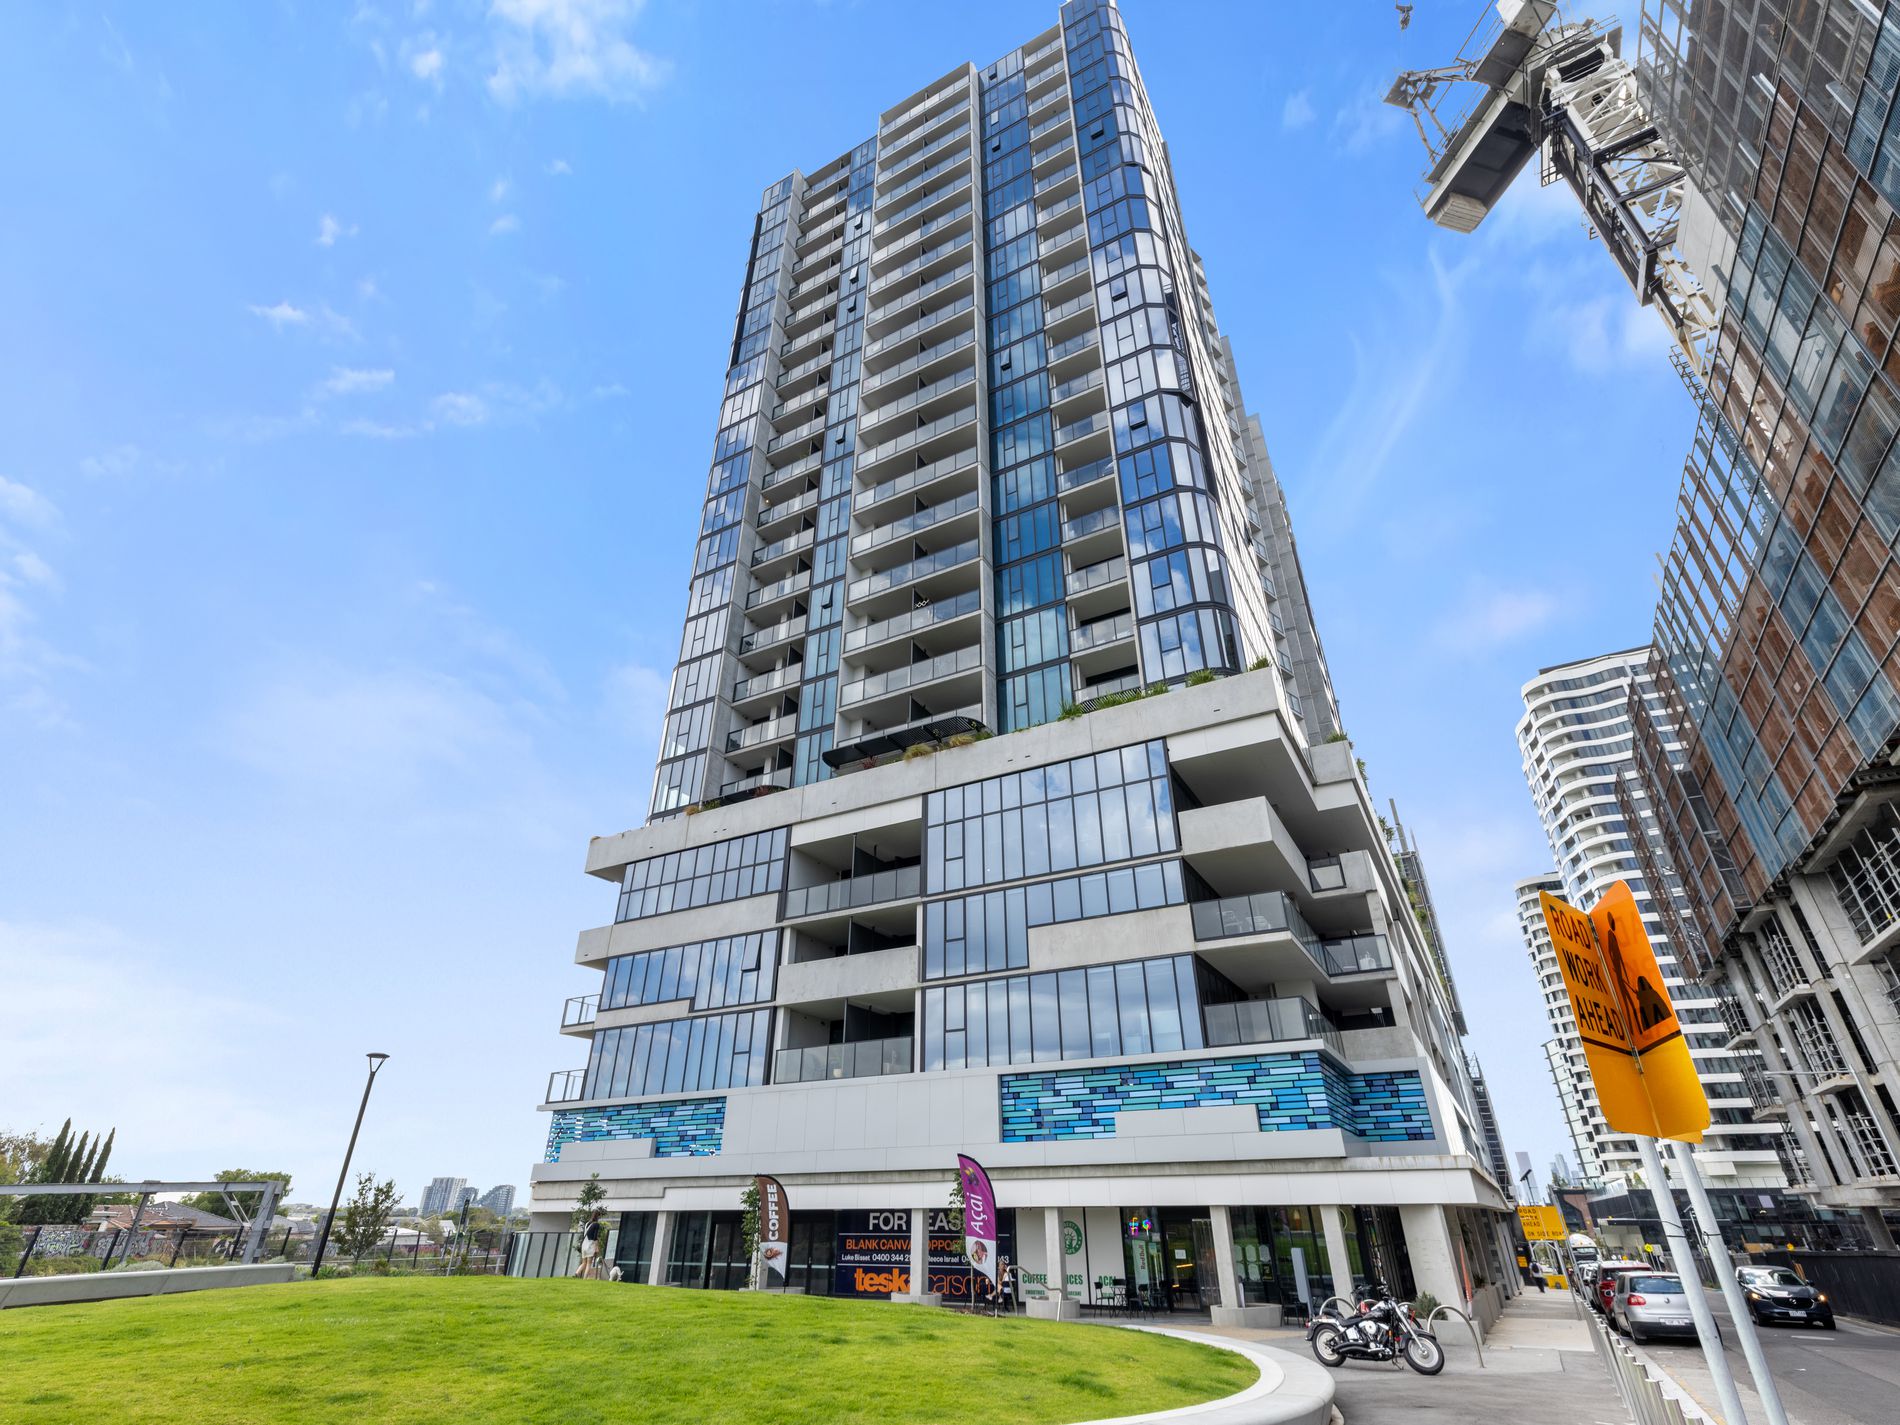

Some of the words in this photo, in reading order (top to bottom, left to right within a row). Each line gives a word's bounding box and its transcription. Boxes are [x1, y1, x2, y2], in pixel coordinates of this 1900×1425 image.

[1549, 904, 1591, 950] ROAD
[1562, 947, 1608, 995] WORK
[1576, 994, 1625, 1041] AHEAD
[767, 1183, 779, 1241] COFFEE
[868, 1212, 907, 1231] FOR
[929, 1212, 962, 1231] EAS
[966, 1192, 988, 1235] Açai
[846, 1239, 879, 1250] BLANK
[880, 1239, 911, 1250] CANV
[872, 1253, 890, 1261] 0400
[854, 1268, 911, 1293] tesk
[1066, 1275, 1083, 1285] ICES
